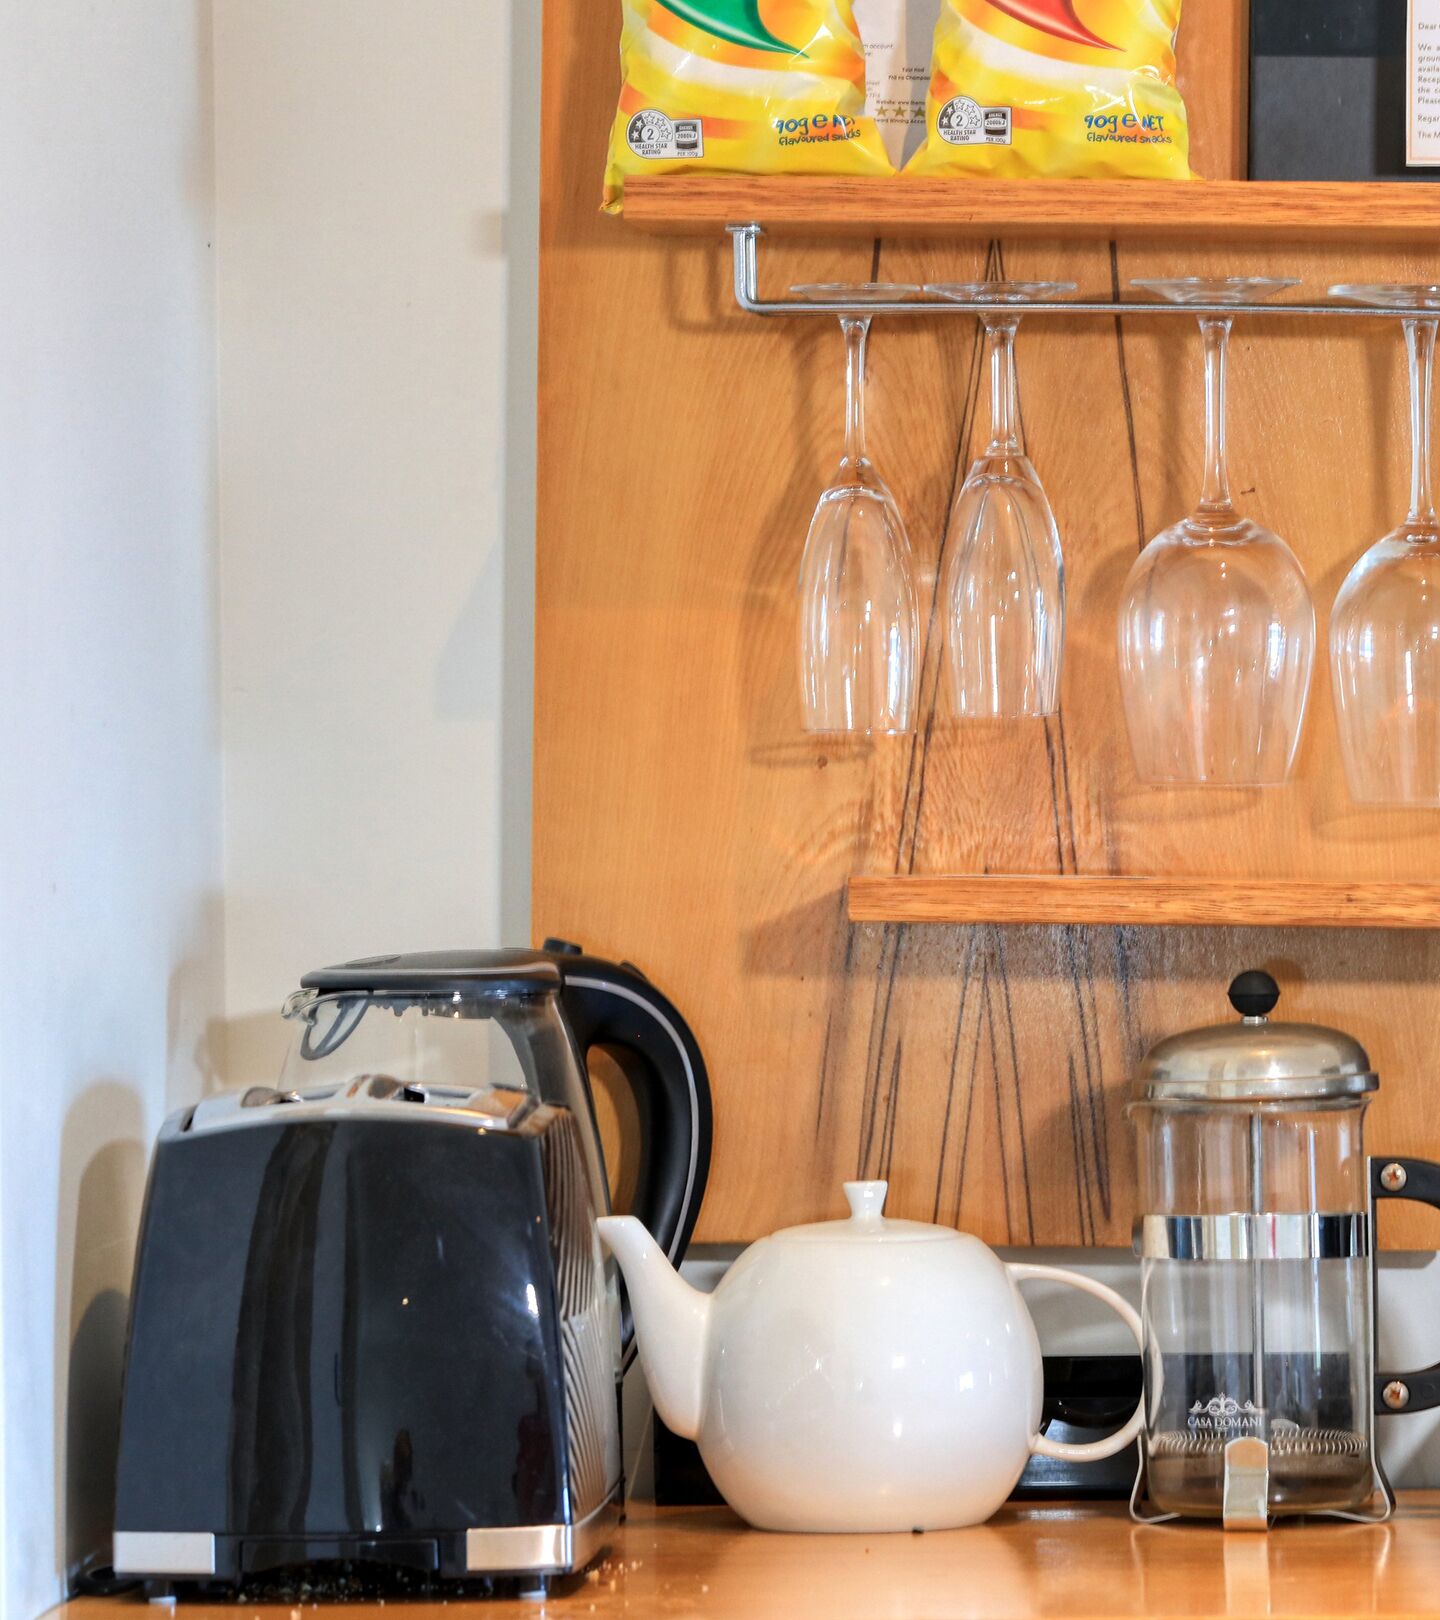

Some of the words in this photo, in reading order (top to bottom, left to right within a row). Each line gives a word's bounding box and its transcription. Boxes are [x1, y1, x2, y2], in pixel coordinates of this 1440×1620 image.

[1418, 22, 1437, 31] Dear
[1417, 44, 1432, 52] We
[1417, 86, 1431, 94] the
[776, 117, 809, 136] 90g
[1084, 114, 1118, 134] 90g
[1141, 114, 1164, 131] NET
[778, 133, 829, 146] flavoured
[1086, 132, 1138, 143] flavoured
[1139, 134, 1173, 144] snacks
[1417, 131, 1432, 140] The
[1187, 1416, 1212, 1427] CASA
[1214, 1416, 1262, 1428] DOMANI
